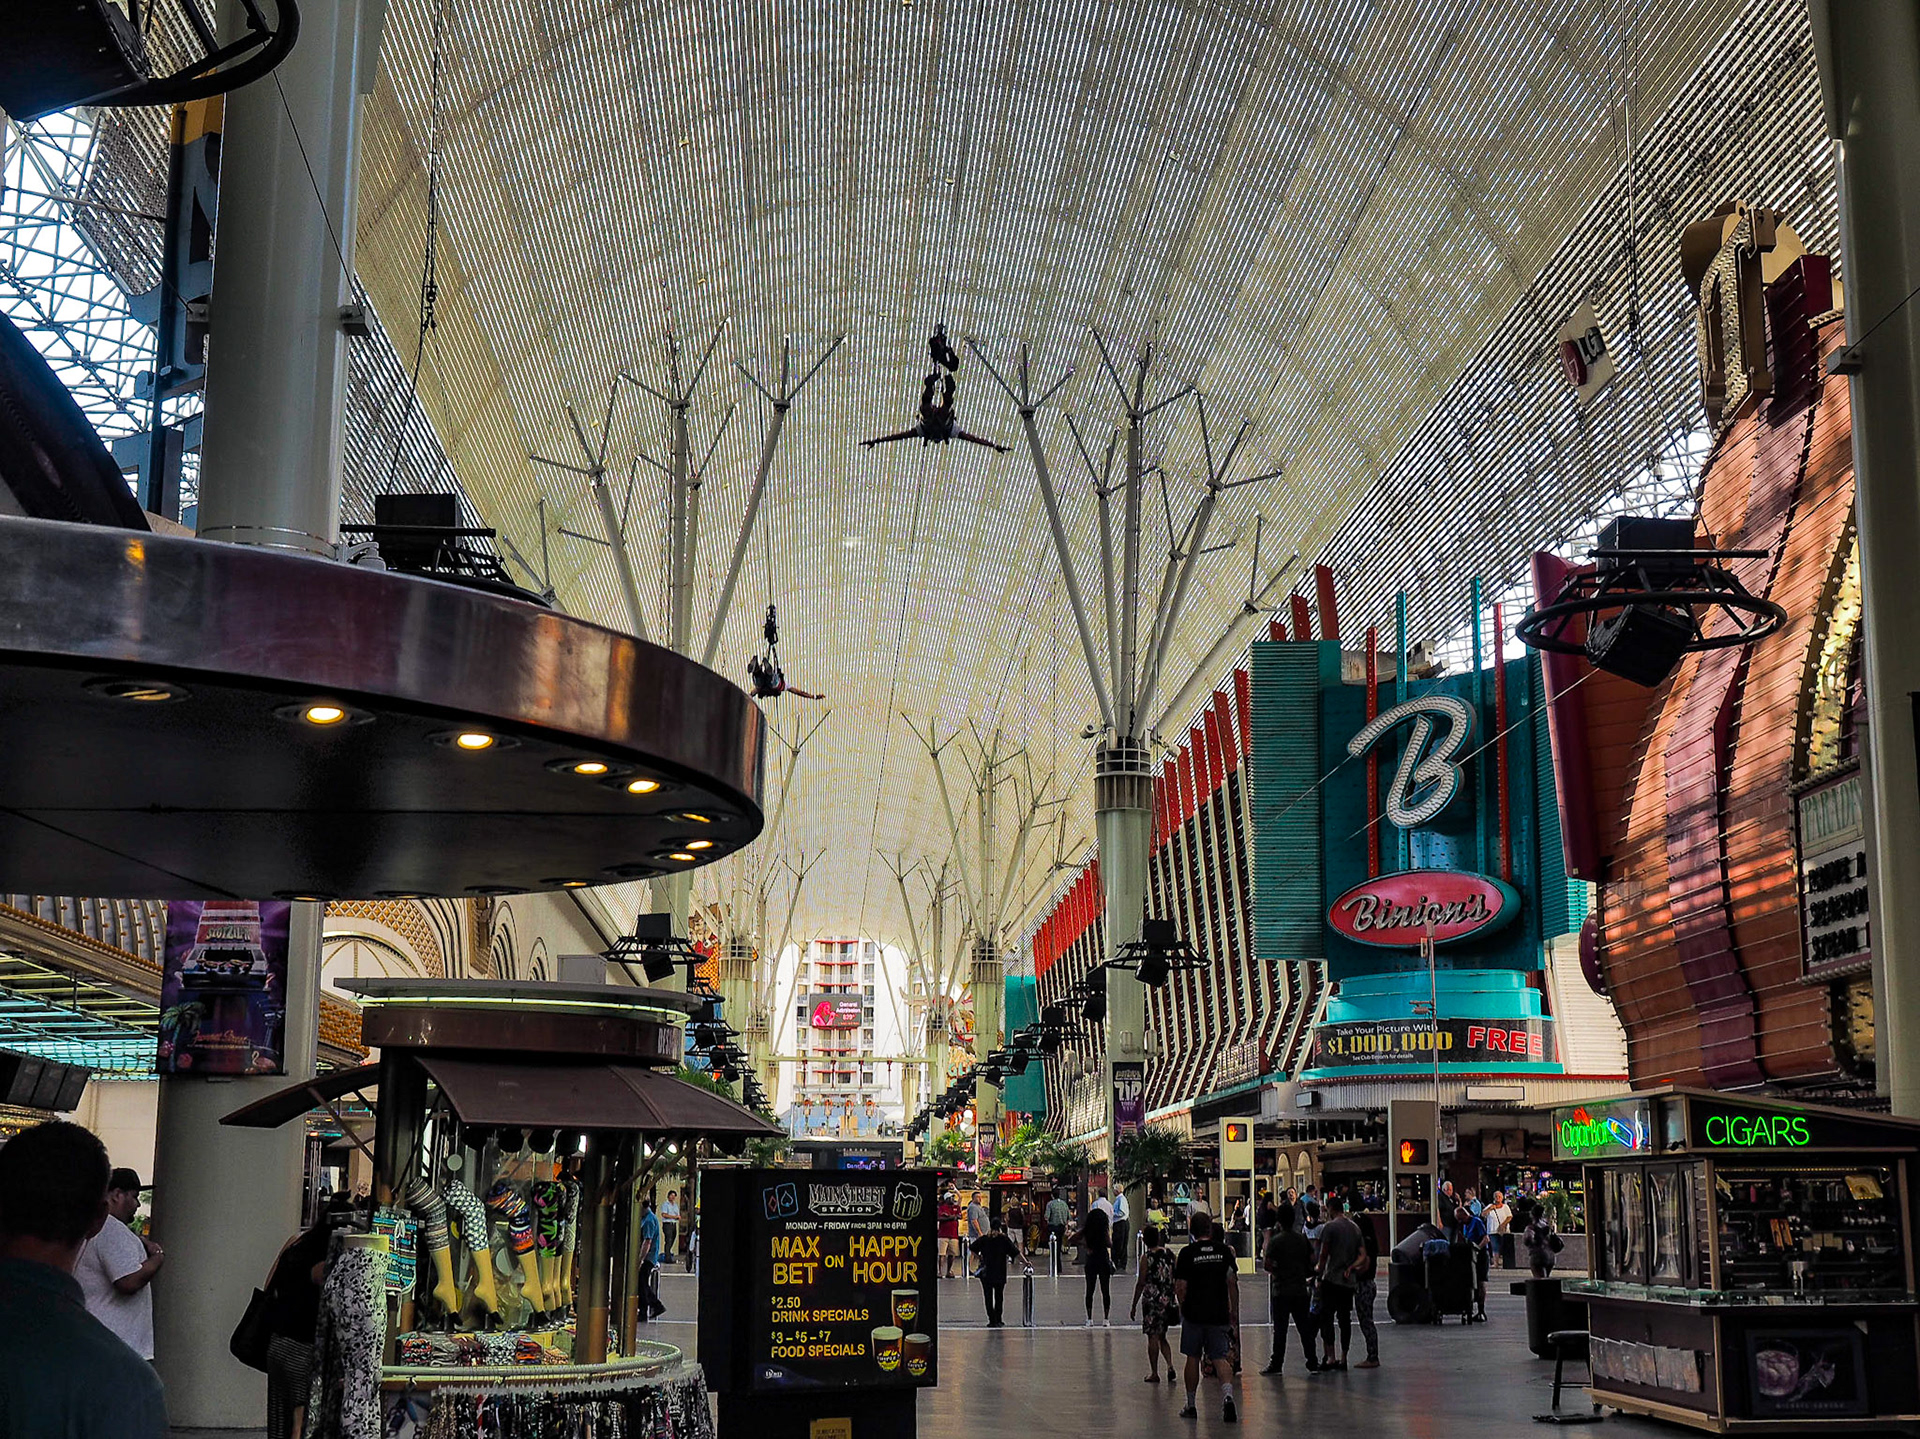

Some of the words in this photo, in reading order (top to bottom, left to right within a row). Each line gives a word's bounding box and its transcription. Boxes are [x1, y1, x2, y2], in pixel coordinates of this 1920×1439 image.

[1347, 695, 1475, 829] B
[1342, 894, 1492, 932] Binion's
[1336, 1028, 1354, 1036] Take
[1354, 1027, 1375, 1035] Your
[1377, 1025, 1411, 1033] Picture
[1412, 1024, 1438, 1032] With
[1467, 1026, 1543, 1056] FREE
[1327, 1031, 1453, 1057] $1,000,000
[1706, 1115, 1810, 1147] CIGARS
[809, 1184, 841, 1205] MAIN
[838, 1183, 886, 1209] STREET
[785, 1222, 817, 1230] MONDAY
[823, 1222, 850, 1230] FRIDAY
[867, 1222, 882, 1230] 3PM
[891, 1222, 907, 1230] 6PM
[771, 1236, 820, 1259] MAX
[849, 1235, 922, 1258] HAPPY
[825, 1255, 844, 1268] ON
[853, 1261, 918, 1284] HOUR
[773, 1262, 818, 1285] BET
[771, 1296, 801, 1309] $2.50
[772, 1310, 810, 1323] DRINK
[812, 1308, 869, 1322] SPECIALS
[771, 1331, 783, 1344] $3
[795, 1330, 808, 1343] $5
[819, 1330, 831, 1342] $7
[771, 1346, 805, 1359] FOOD
[808, 1343, 865, 1357] SPECIALS
